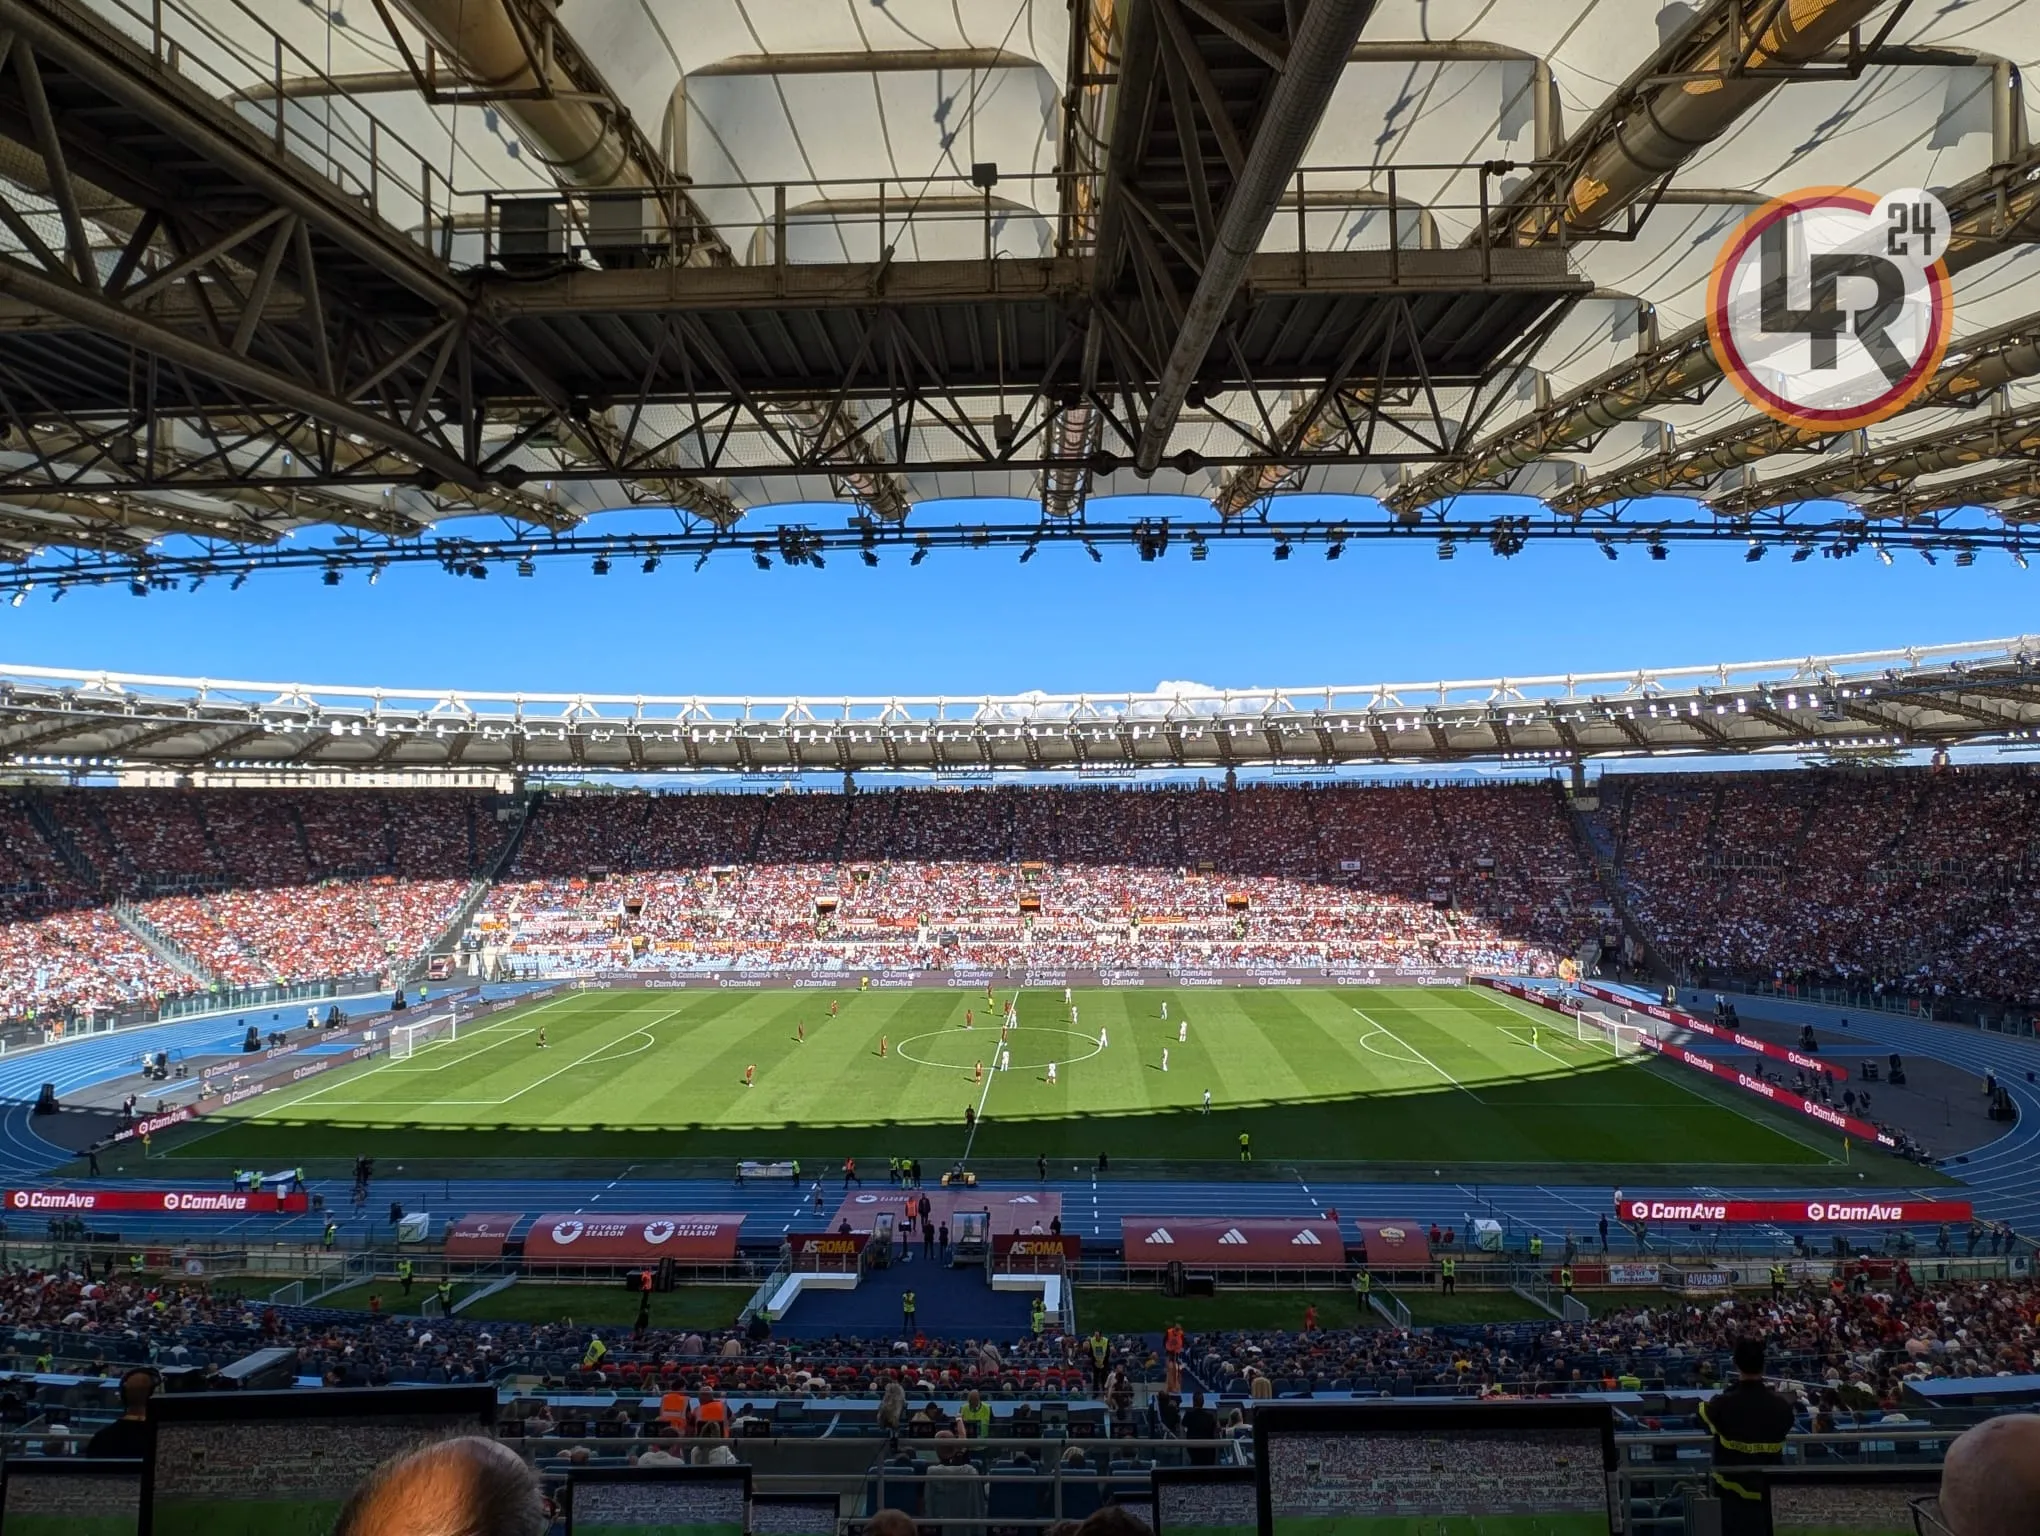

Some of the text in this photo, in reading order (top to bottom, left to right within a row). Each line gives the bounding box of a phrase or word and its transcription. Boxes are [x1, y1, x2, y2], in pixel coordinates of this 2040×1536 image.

[748, 971, 779, 979] ComAe
[1403, 968, 1437, 976] ComAve
[653, 979, 686, 988] ComAve
[728, 979, 761, 987] ComAve
[803, 979, 837, 987] ComAve
[880, 979, 913, 987] ComAve
[1110, 978, 1145, 986] ComAve
[1188, 978, 1223, 986] ComAve
[1346, 977, 1381, 985] ComAve
[1426, 977, 1461, 986] ComAve
[1741, 1036, 1764, 1051] ComAve
[212, 1061, 240, 1076] ComAve
[300, 1061, 329, 1077] ComAve
[1690, 1054, 1714, 1072] ComAve
[232, 1084, 264, 1102] ComAve
[1745, 1077, 1774, 1097] ComAve
[149, 1109, 188, 1131] ComAve
[1812, 1104, 1846, 1128] ComAve
[30, 1192, 95, 1209] ComAve
[180, 1194, 247, 1211] ComAve
[1651, 1202, 1726, 1220] ComAve
[1827, 1204, 1903, 1221] ComAve
